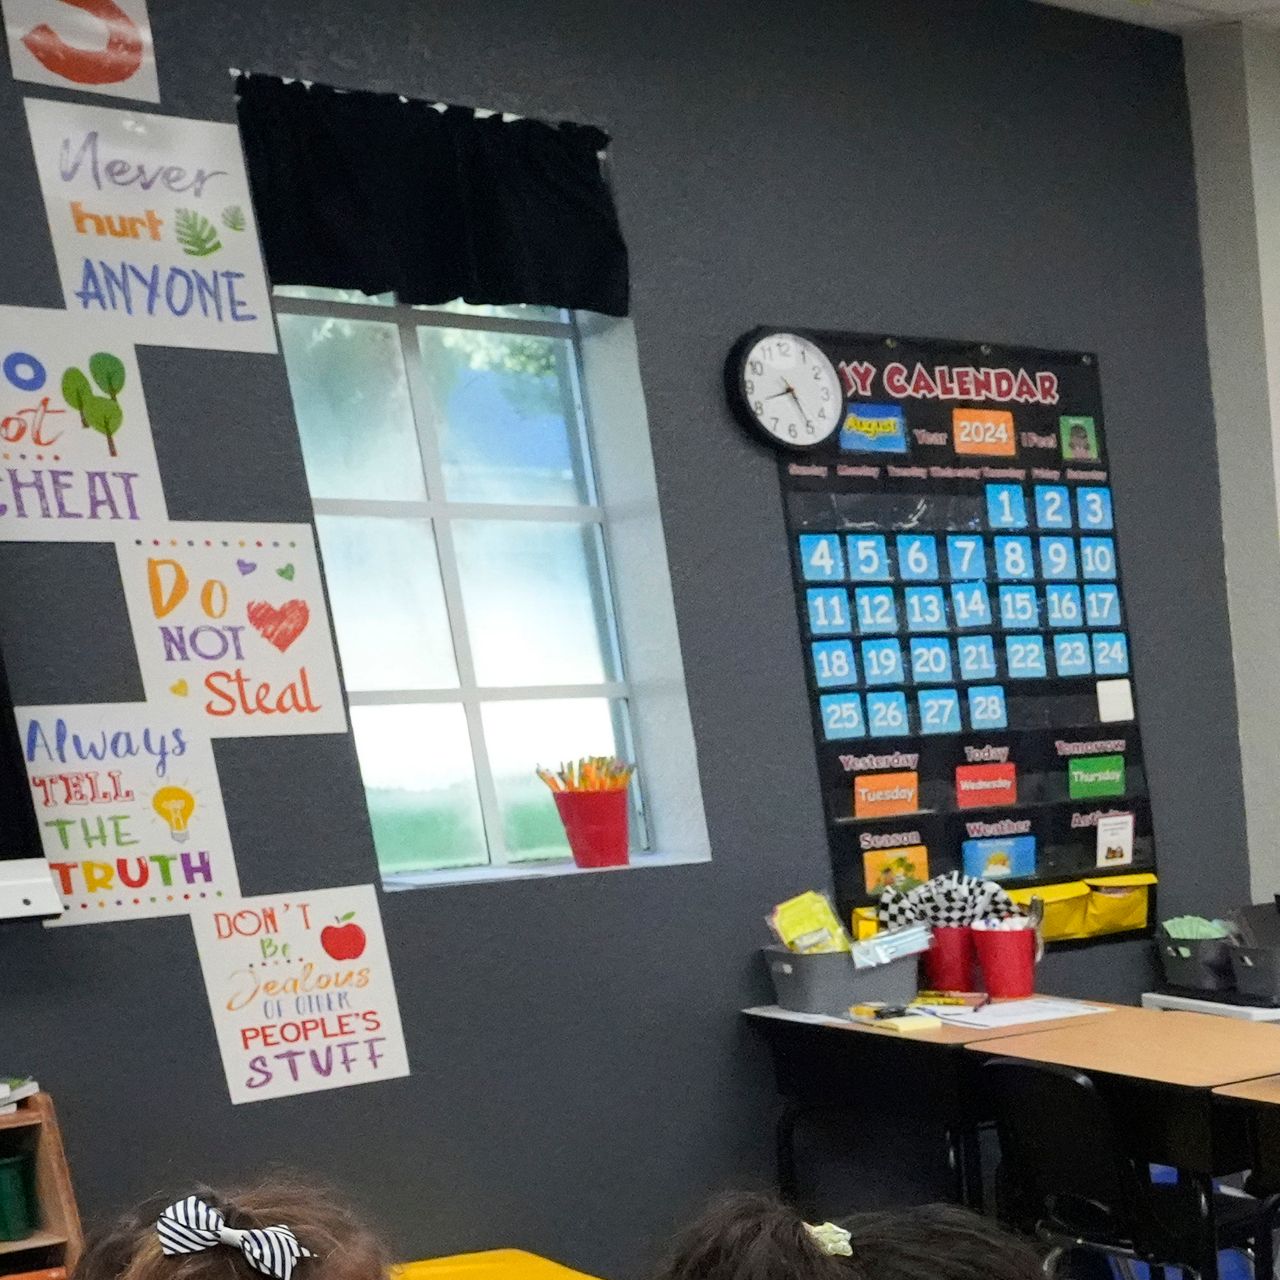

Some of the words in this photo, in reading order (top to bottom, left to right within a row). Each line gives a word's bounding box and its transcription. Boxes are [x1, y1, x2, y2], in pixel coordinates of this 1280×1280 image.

[58, 130, 229, 198] Never
[69, 200, 164, 241] hurt
[74, 257, 257, 323] ANYONE
[883, 361, 1060, 405] CALENDAR
[959, 421, 1009, 443] 2024
[1001, 490, 1015, 522] 1
[1045, 492, 1062, 522] 2
[1086, 493, 1103, 524] 3
[810, 539, 834, 574] 4
[858, 539, 879, 573] 5
[908, 540, 928, 573] 6
[956, 540, 976, 573] 7
[1004, 540, 1023, 573] 8
[1049, 542, 1067, 573] 9
[1083, 546, 1111, 572] 10
[147, 557, 230, 620] Do
[814, 596, 845, 626] 11
[861, 596, 892, 624] 12
[910, 594, 941, 622] 13
[957, 587, 985, 617] 14
[1003, 591, 1033, 619] 15
[1050, 593, 1077, 619] 16
[1089, 591, 1114, 618] 17
[159, 625, 246, 662] NOT
[818, 650, 849, 677] 18
[867, 649, 898, 676] 19
[914, 646, 947, 673] 20
[963, 645, 989, 671] 21
[1010, 643, 1042, 669] 22
[1059, 641, 1086, 666] 23
[1097, 640, 1125, 664] 24
[204, 667, 322, 717] Steal
[828, 706, 859, 729] 25
[873, 702, 902, 727] 26
[924, 699, 953, 723] 27
[974, 696, 999, 719] 28
[25, 718, 190, 777] Always
[839, 752, 919, 771] Yesterday
[964, 745, 1010, 763] Today
[1055, 739, 1126, 755] Tomorrow
[31, 770, 135, 807] TELL
[859, 786, 915, 802] Tuesday
[960, 778, 1012, 791] Wednesday
[1072, 770, 1122, 782] Thursday
[44, 814, 141, 850] THE
[859, 830, 920, 849] Season
[966, 819, 1031, 838] Weather
[49, 850, 213, 896] TRUTH
[213, 903, 311, 939] DON'T
[260, 937, 290, 959] Be
[226, 962, 371, 1012] Jealous
[240, 1010, 381, 1050] PEOPLE'S
[246, 1037, 387, 1089] STUFF
